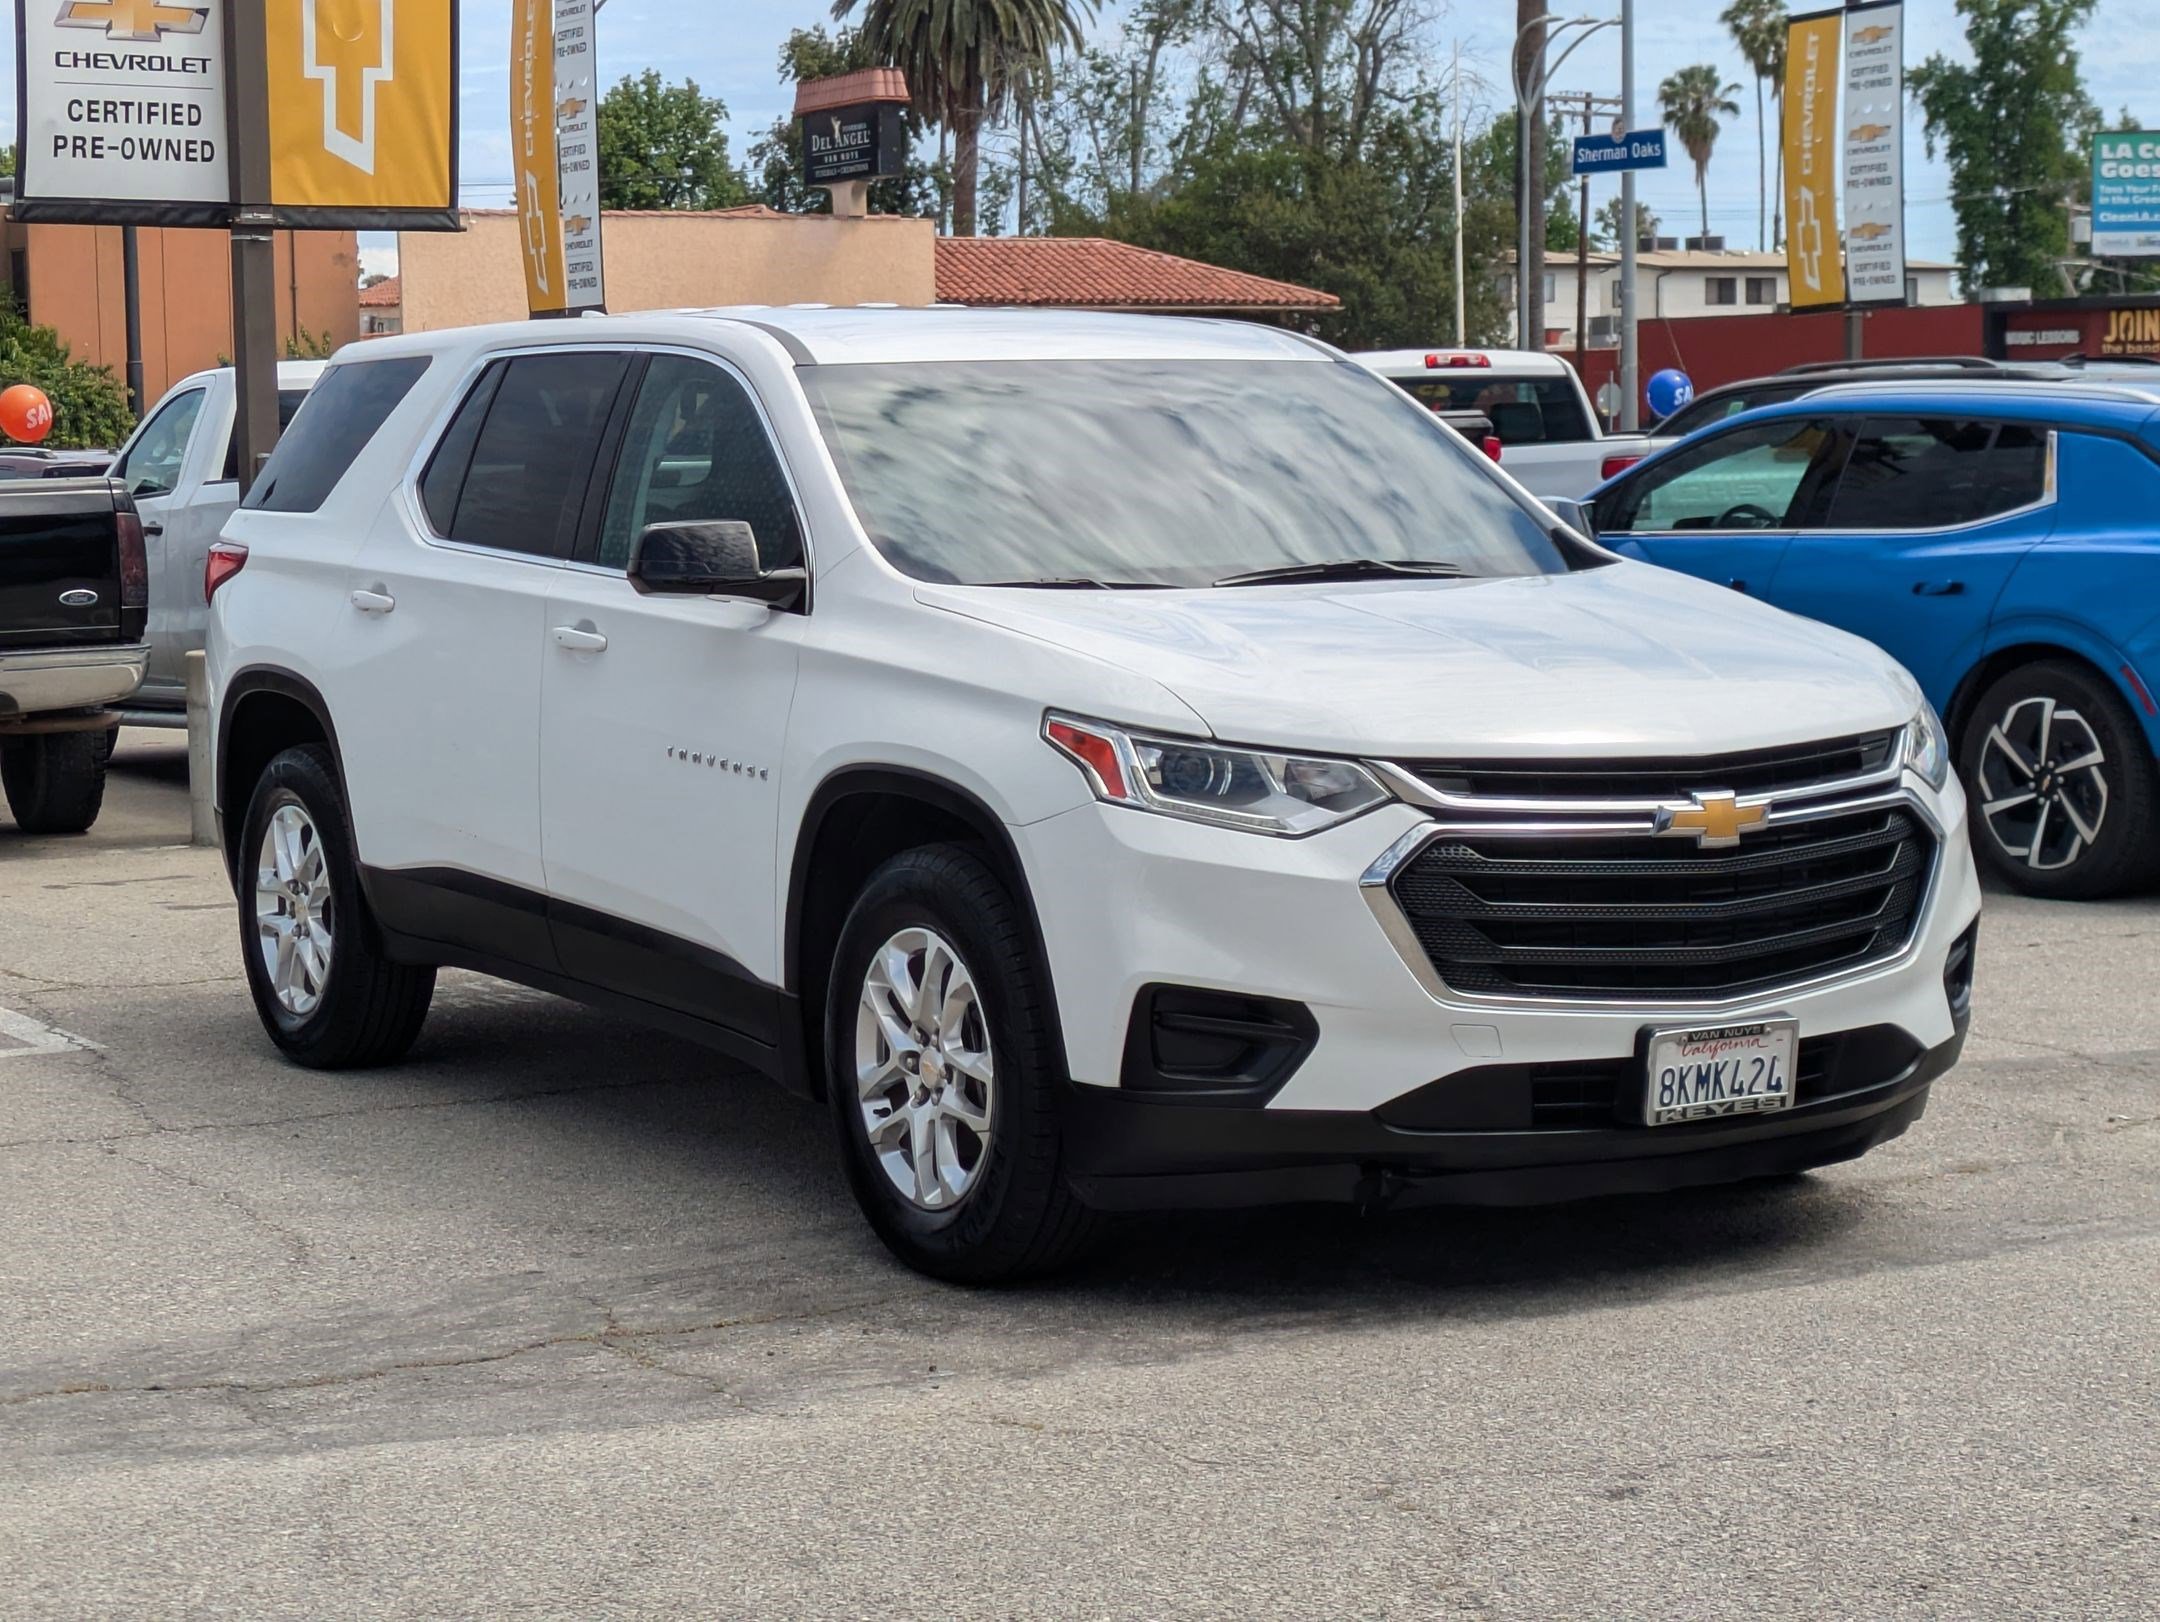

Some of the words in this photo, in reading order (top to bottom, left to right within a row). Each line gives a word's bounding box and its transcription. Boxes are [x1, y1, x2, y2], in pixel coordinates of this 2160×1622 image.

[1849, 46, 1892, 58] CHEVROLET
[55, 51, 212, 74] CHEVROLET
[1851, 64, 1889, 78] CERTIFIED
[1803, 32, 1819, 175] CHEVROLET
[67, 99, 202, 127] CERTIFIED
[53, 135, 216, 163] PRE-OWNED
[1578, 147, 1627, 163] Sherman
[1632, 142, 1661, 158] Oaks
[1847, 144, 1891, 156] CHEVROLET
[2101, 143, 2134, 160] LA
[1850, 162, 1888, 176] CERTIFIED
[1847, 176, 1893, 189] PRE-OWNED
[1850, 243, 1893, 254] CHEVROLET
[1854, 261, 1891, 273] CERTIFIED
[1853, 275, 1896, 286] PRE-OWNED
[2103, 309, 2160, 343] JOIN
[2102, 343, 2123, 354] the
[2126, 343, 2160, 354] band
[1692, 1031, 1720, 1041] VAN
[1724, 1026, 1761, 1037] NUYS
[1681, 1037, 1768, 1059] California
[1659, 1056, 1783, 1107] 8KMK424
[1659, 1096, 1781, 1122] KEYES
